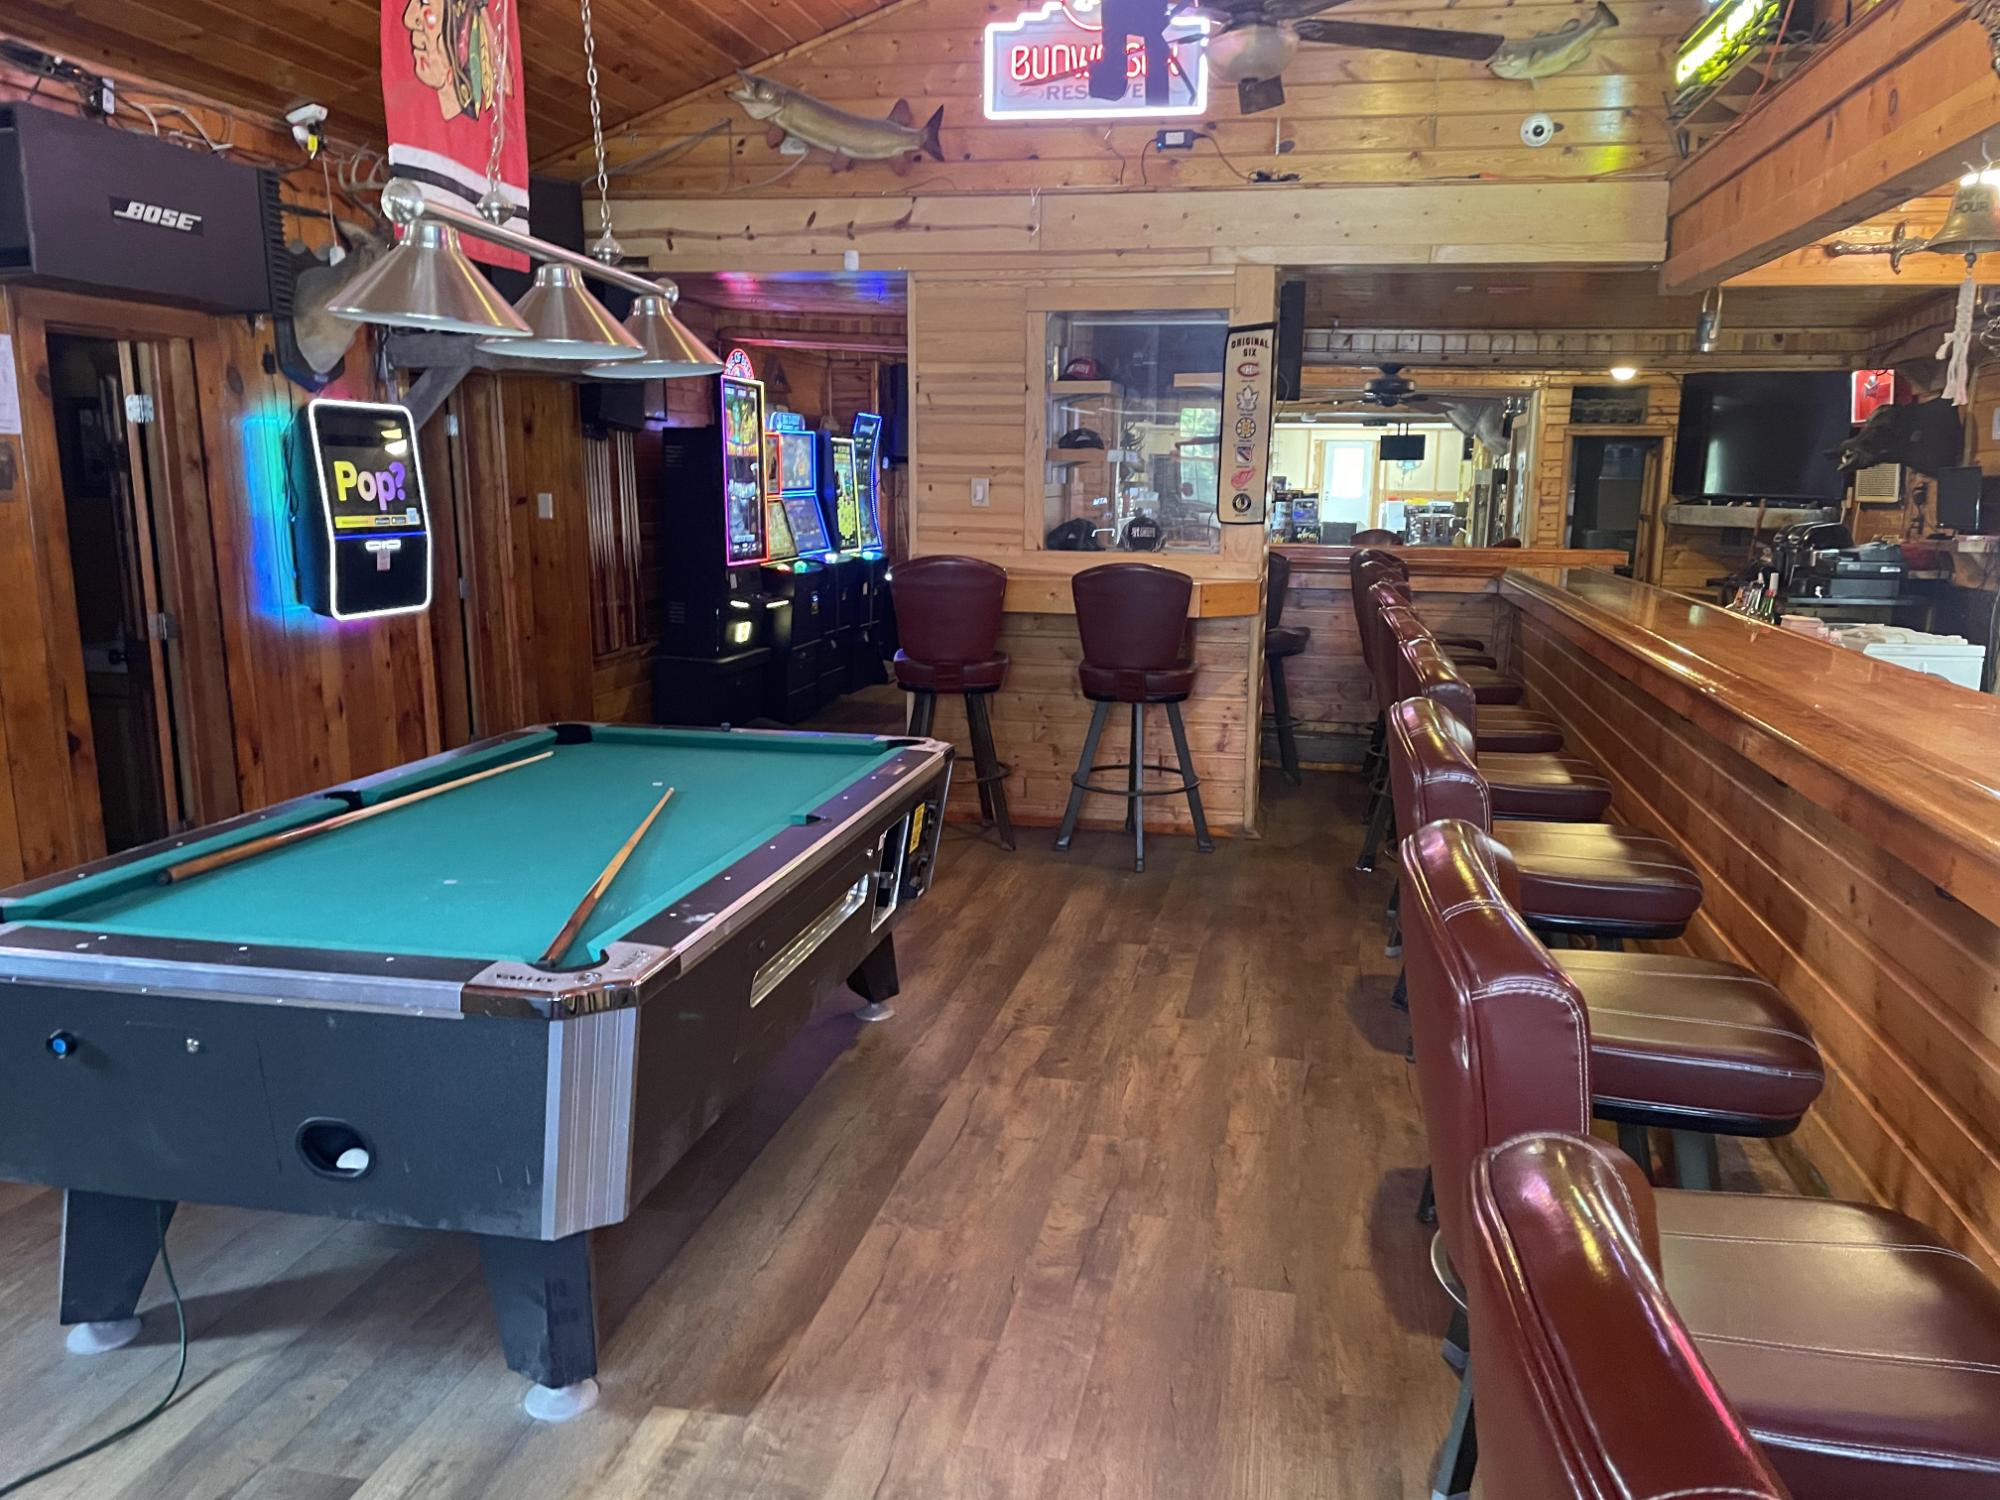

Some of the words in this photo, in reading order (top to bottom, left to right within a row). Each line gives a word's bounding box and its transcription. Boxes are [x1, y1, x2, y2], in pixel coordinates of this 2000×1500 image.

[113, 200, 202, 231] BOSE
[1231, 337, 1270, 349] ORIGINAL
[1243, 348, 1257, 357] SIX
[333, 460, 407, 511] Pop?
